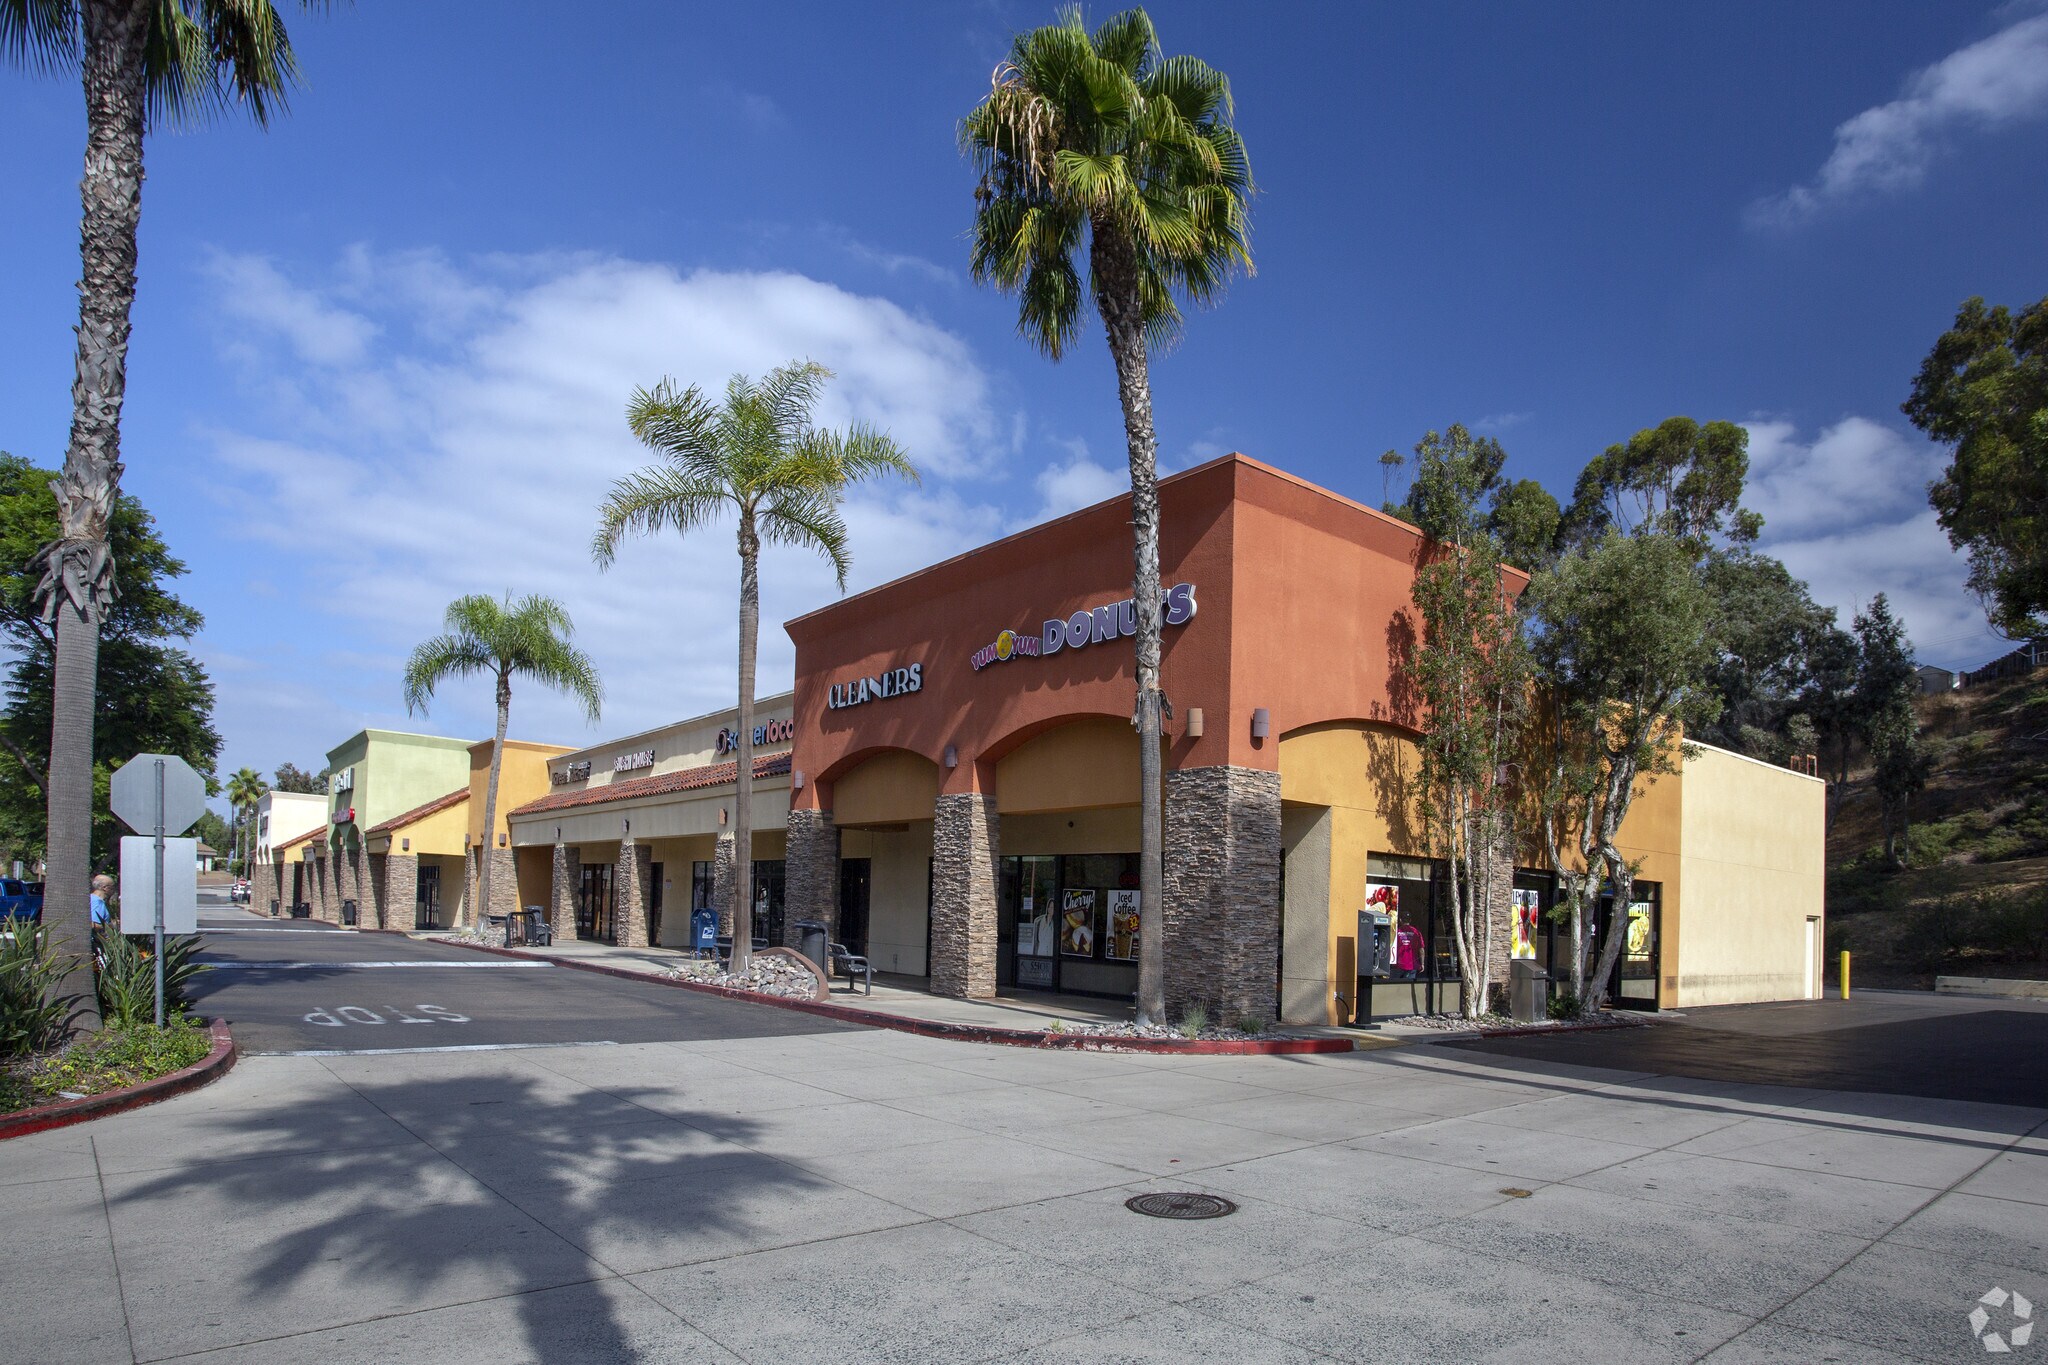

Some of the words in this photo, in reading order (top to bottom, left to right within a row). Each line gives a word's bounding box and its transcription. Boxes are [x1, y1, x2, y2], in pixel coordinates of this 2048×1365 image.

[971, 642, 998, 670] YUM
[1012, 636, 1039, 657] YUM
[1043, 583, 1196, 655] DONUS
[828, 662, 922, 709] CLEANERS
[1113, 903, 1137, 914] Coffee
[1117, 891, 1133, 903] Iced
[303, 1004, 472, 1027] STOP
